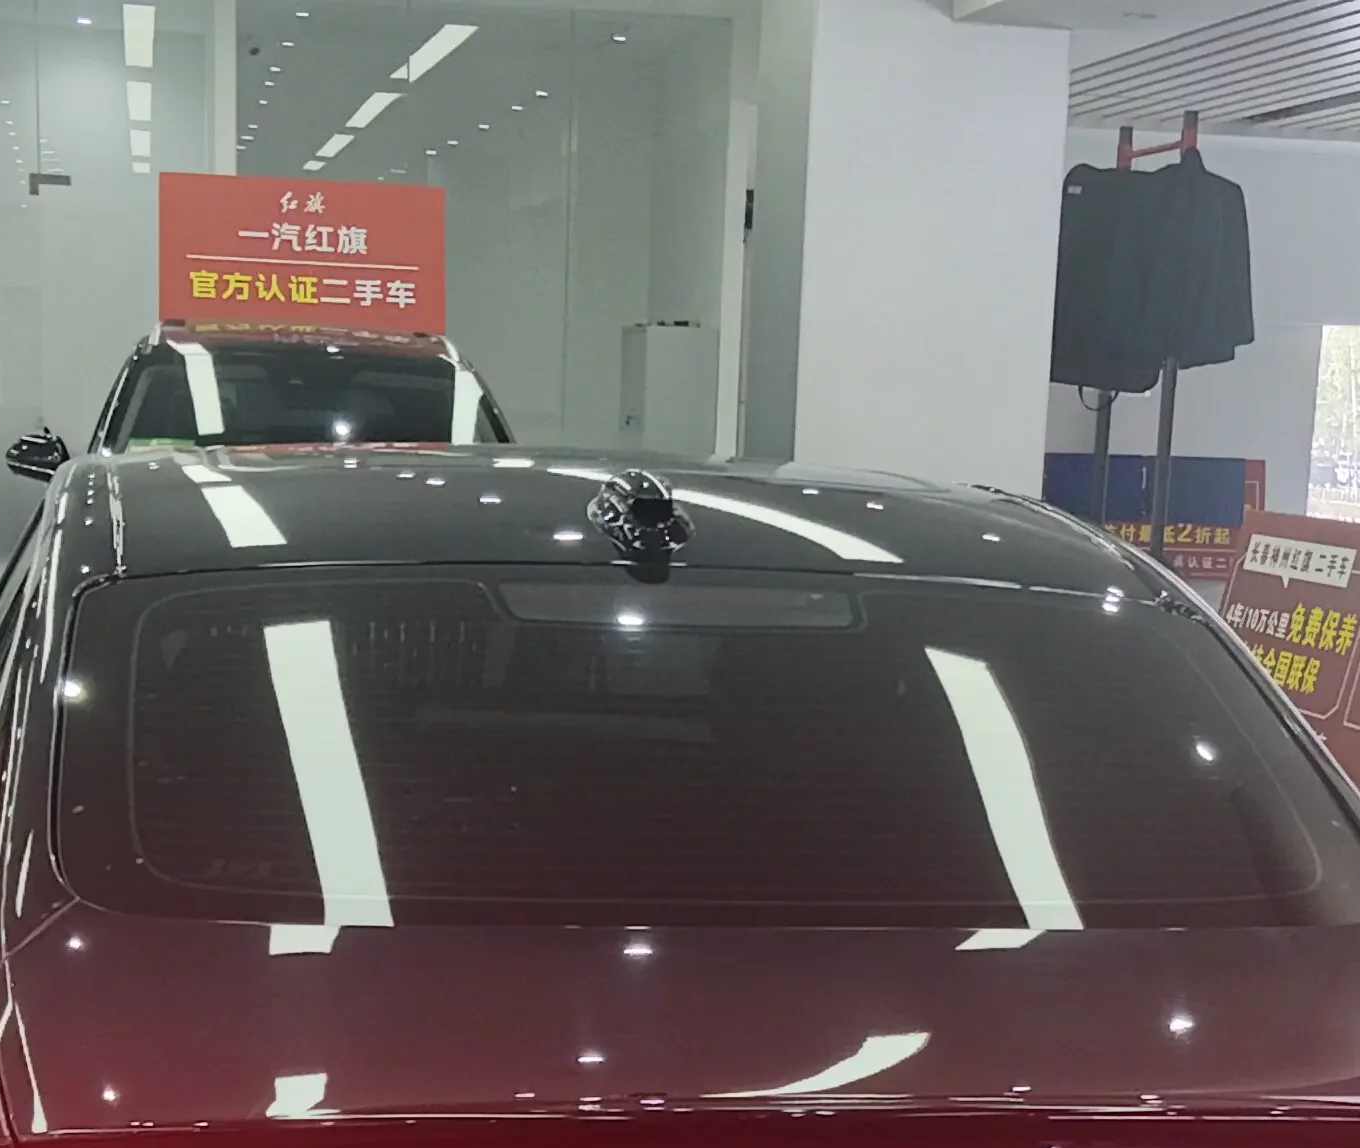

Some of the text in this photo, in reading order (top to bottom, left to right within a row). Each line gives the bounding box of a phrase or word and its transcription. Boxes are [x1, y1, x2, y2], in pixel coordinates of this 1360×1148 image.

[280, 191, 326, 214] 红旗
[238, 222, 368, 255] 一汽红旗
[189, 270, 416, 308] 官方认证二手车
